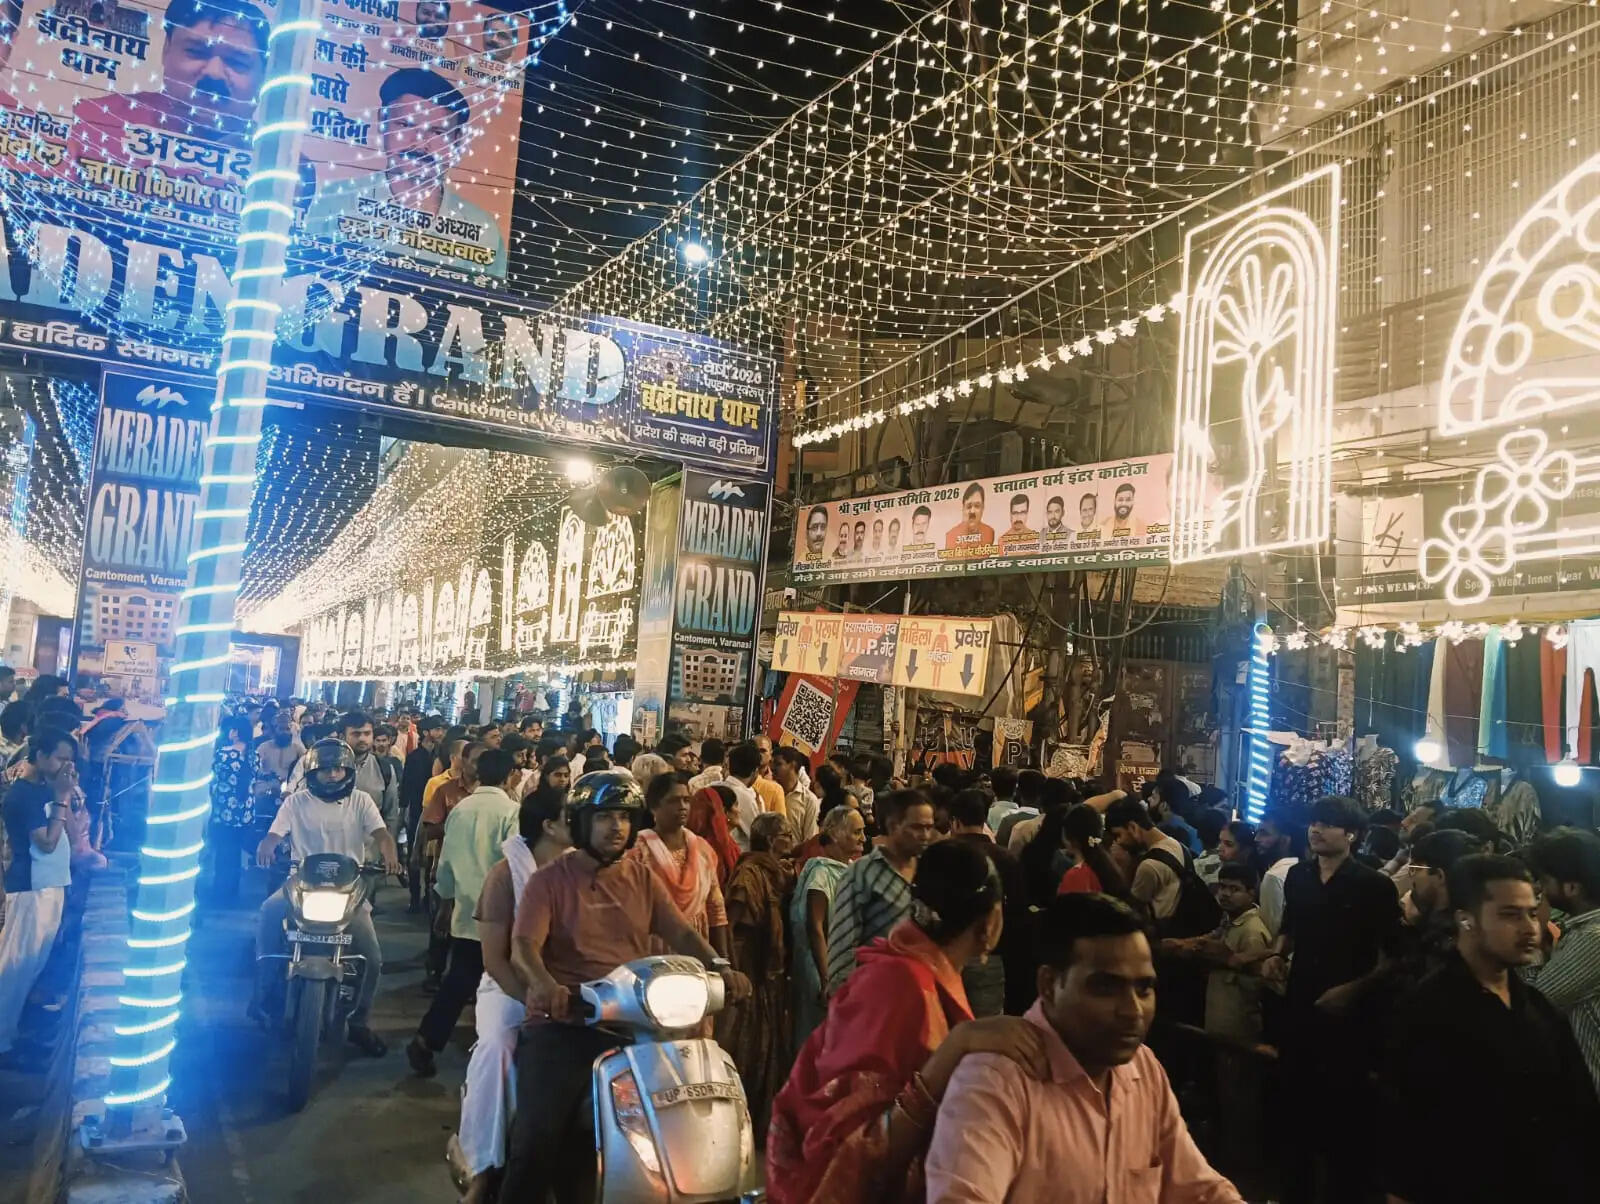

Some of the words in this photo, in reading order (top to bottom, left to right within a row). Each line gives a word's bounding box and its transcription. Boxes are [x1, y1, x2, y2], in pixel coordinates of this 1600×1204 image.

[435, 214, 481, 242] अध्यक्ष
[11, 320, 109, 352] हार्दिक
[117, 339, 215, 370] स्वागत
[266, 362, 387, 400] अभिनंदन
[641, 380, 719, 422] बद्रीनाथ
[721, 397, 761, 430] धाम
[634, 422, 661, 440] प्रदेश
[662, 426, 678, 443] की
[679, 430, 706, 448] सबसे
[708, 434, 728, 454] बड़ी
[729, 439, 761, 459] प्रतिमा
[838, 500, 851, 517] श्री
[852, 498, 872, 518] दुर्गा
[874, 496, 895, 516] पूजा
[897, 489, 932, 508] समिति
[934, 486, 960, 504] 2026
[993, 476, 1039, 494] सनातन
[1042, 471, 1066, 488] धर्म
[1067, 466, 1096, 486] इंटर
[1099, 461, 1150, 482] कालेज
[683, 499, 765, 562] MERADEN
[944, 563, 964, 572] का
[966, 557, 1013, 571] हार्दिक
[1016, 556, 1070, 568] स्वागत
[1073, 552, 1098, 564] एवं
[85, 567, 147, 586] Cantoment,
[1387, 582, 1415, 594] WEAR
[1528, 572, 1553, 585] Inner
[676, 562, 756, 637] GRAND
[776, 618, 799, 637] प्रवेश
[901, 621, 932, 646] महिला
[955, 623, 990, 649] प्रवेश
[674, 632, 718, 647] Cantoment,
[719, 637, 752, 650] Varanasi
[843, 635, 880, 656] V.I.P.
[880, 637, 895, 658] गेट
[849, 666, 878, 681] स्वागतम्
